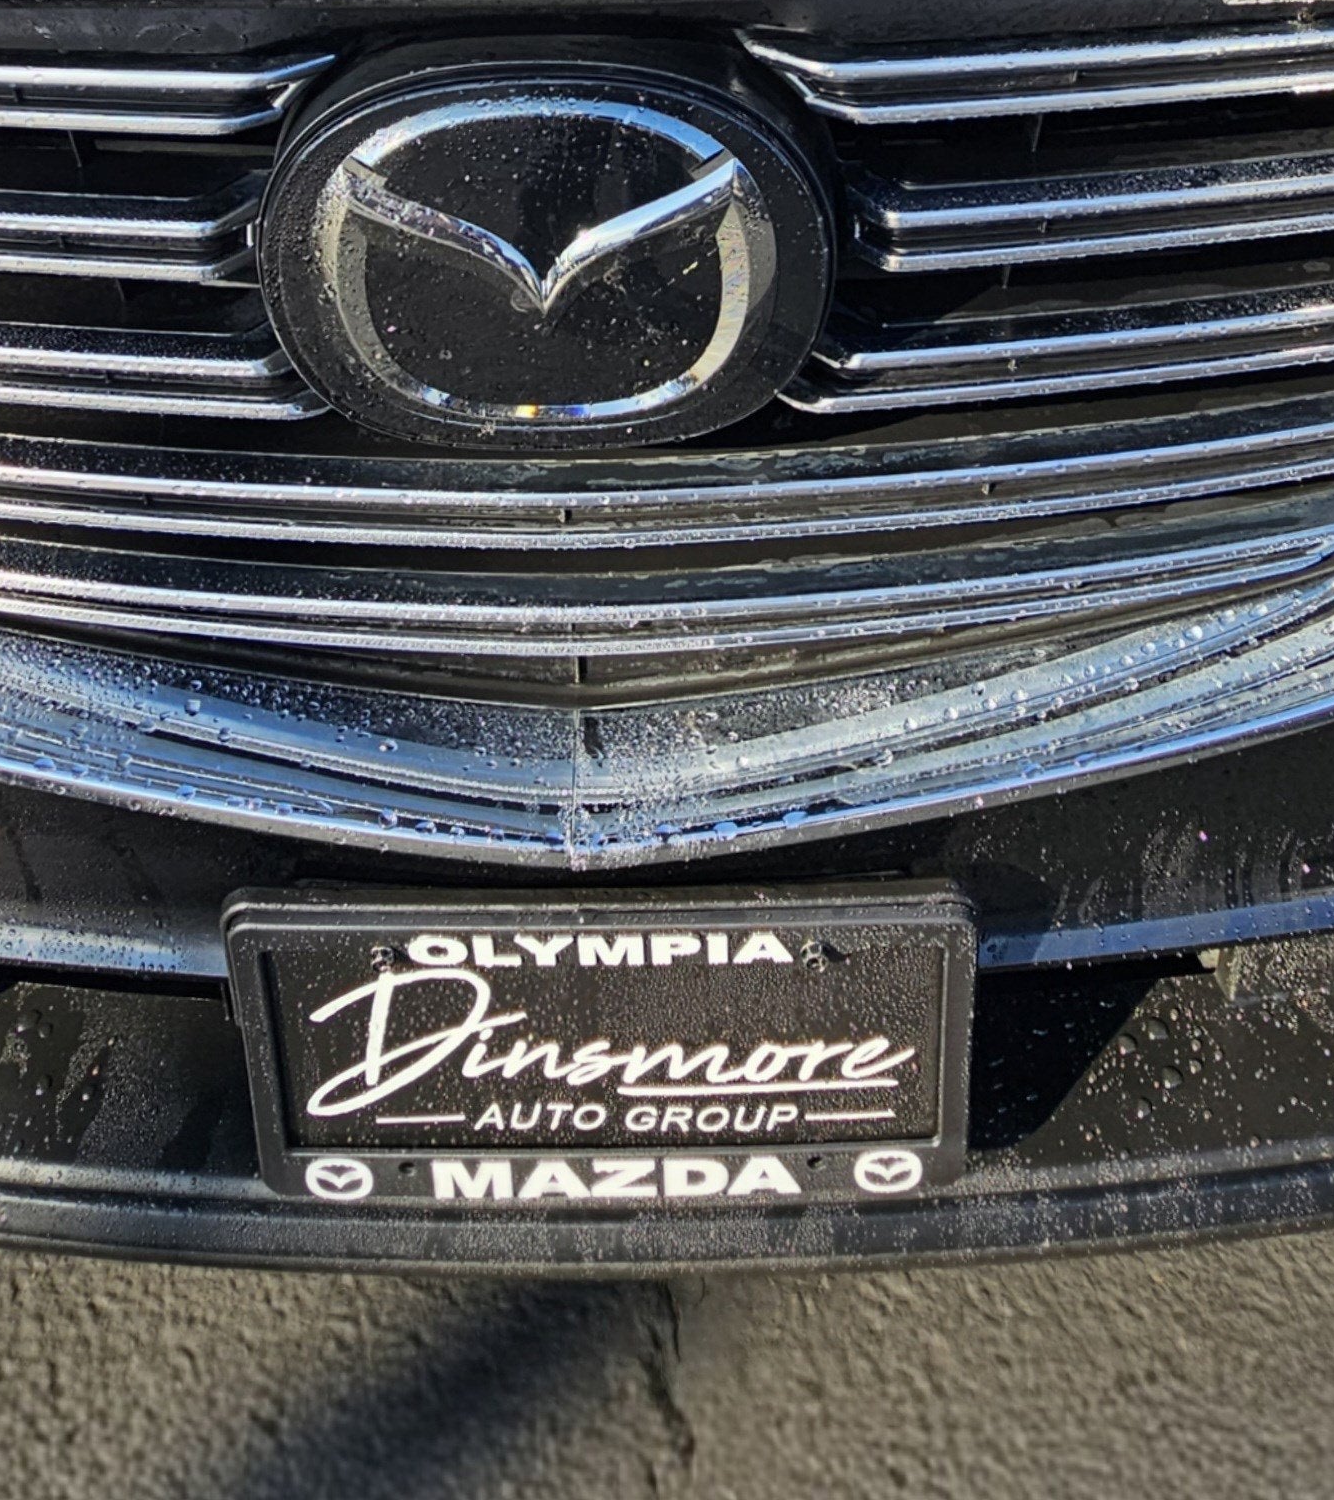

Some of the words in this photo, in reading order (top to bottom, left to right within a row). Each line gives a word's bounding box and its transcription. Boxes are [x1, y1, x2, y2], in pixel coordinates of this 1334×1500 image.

[407, 933, 793, 968] OLYMPIA
[307, 967, 914, 1116] Dinsmore
[474, 1102, 602, 1133] AUTO
[625, 1102, 799, 1132] GROUP
[431, 1155, 802, 1199] MAZDA
